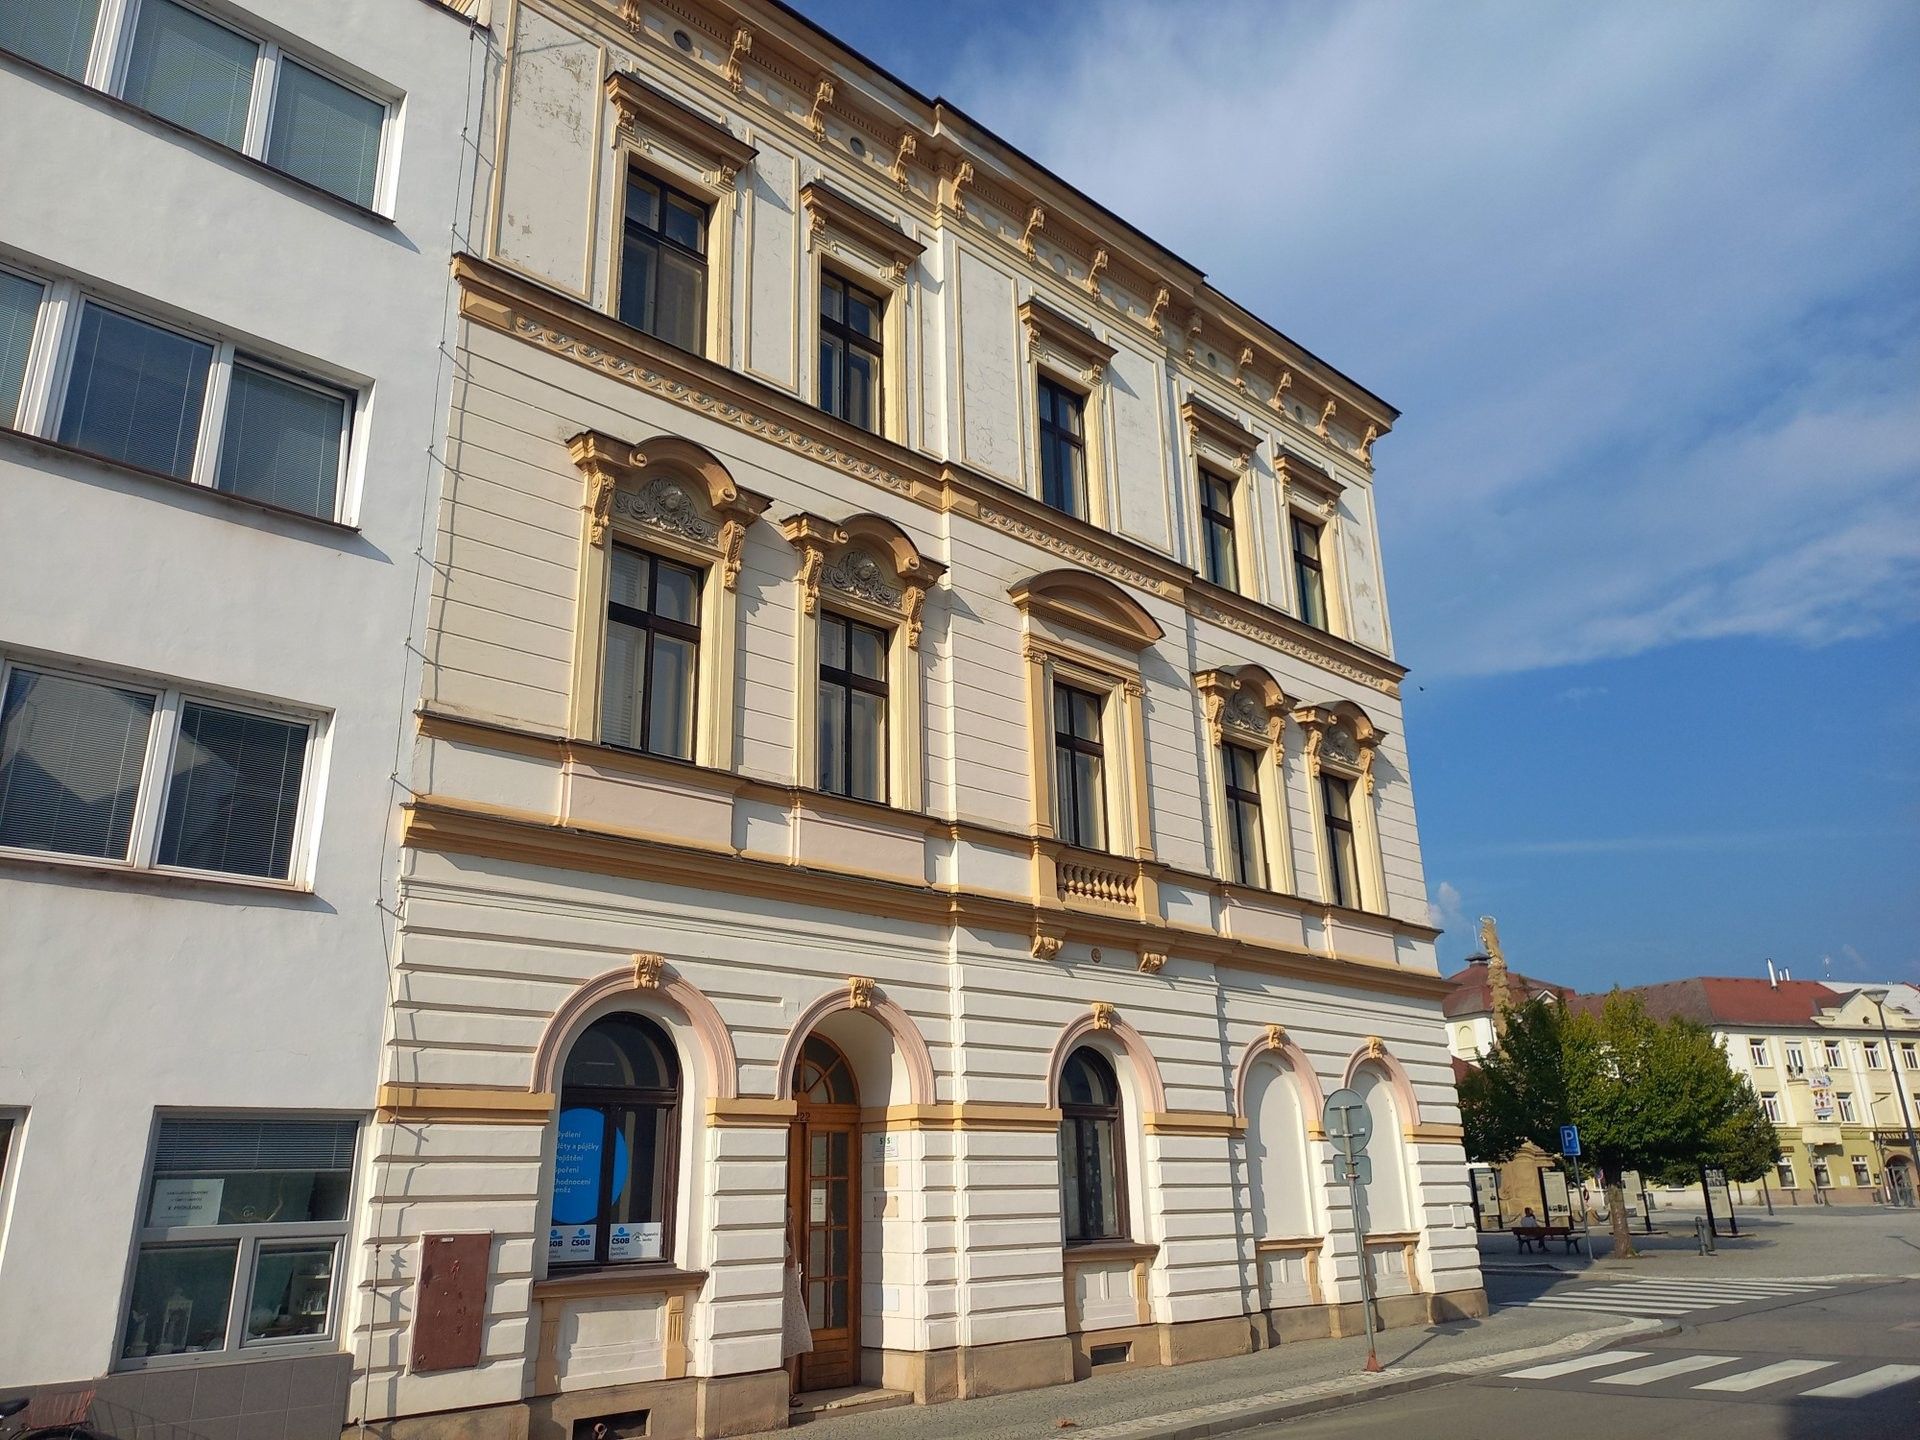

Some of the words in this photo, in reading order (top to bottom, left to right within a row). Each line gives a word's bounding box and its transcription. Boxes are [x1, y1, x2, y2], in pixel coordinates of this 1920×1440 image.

[1564, 1130, 1574, 1146] P
[555, 1166, 579, 1175] poření
[555, 1178, 591, 1186] hodnocení
